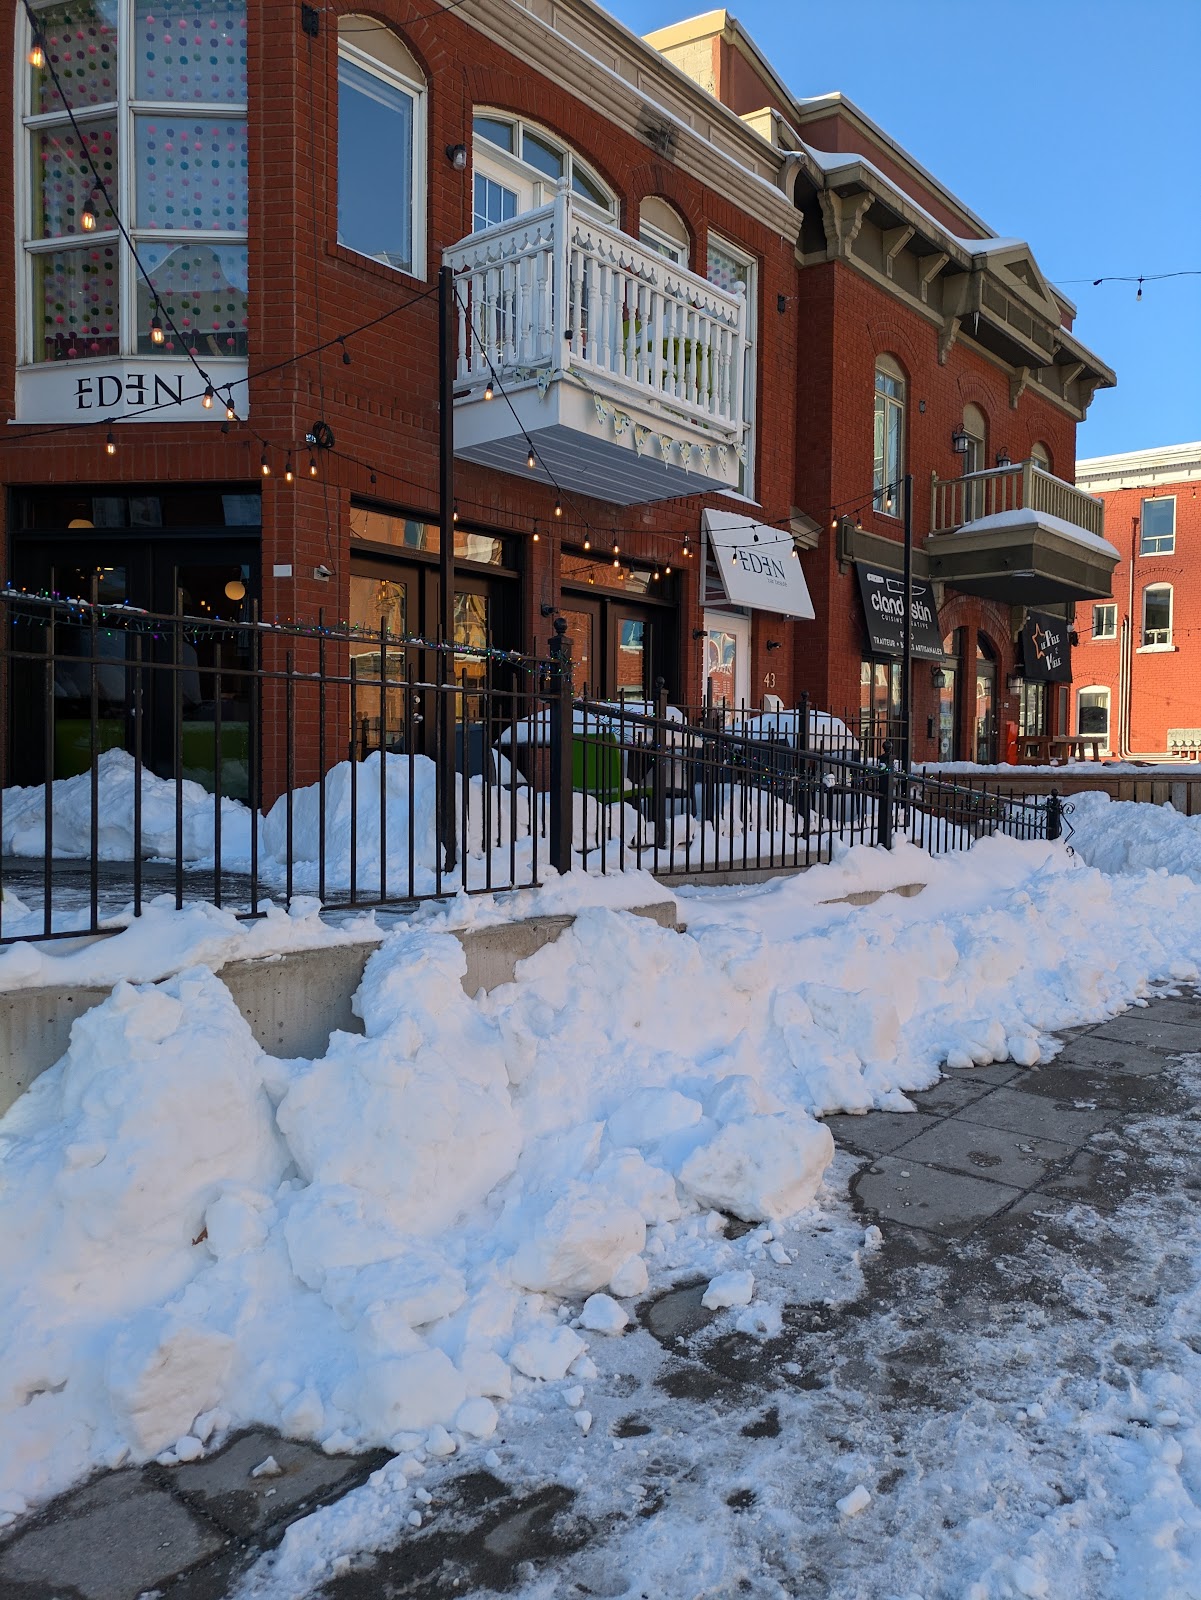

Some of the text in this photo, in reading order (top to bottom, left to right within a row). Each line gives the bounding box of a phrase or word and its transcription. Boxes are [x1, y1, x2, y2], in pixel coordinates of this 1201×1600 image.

[74, 374, 185, 409] EDEN
[738, 550, 786, 580] EDEN
[871, 590, 932, 622] clandstin
[881, 614, 903, 624] CUISINE
[873, 636, 896, 648] TRAITEUR
[915, 644, 943, 656] ARTISANALES
[763, 673, 776, 688] 43
